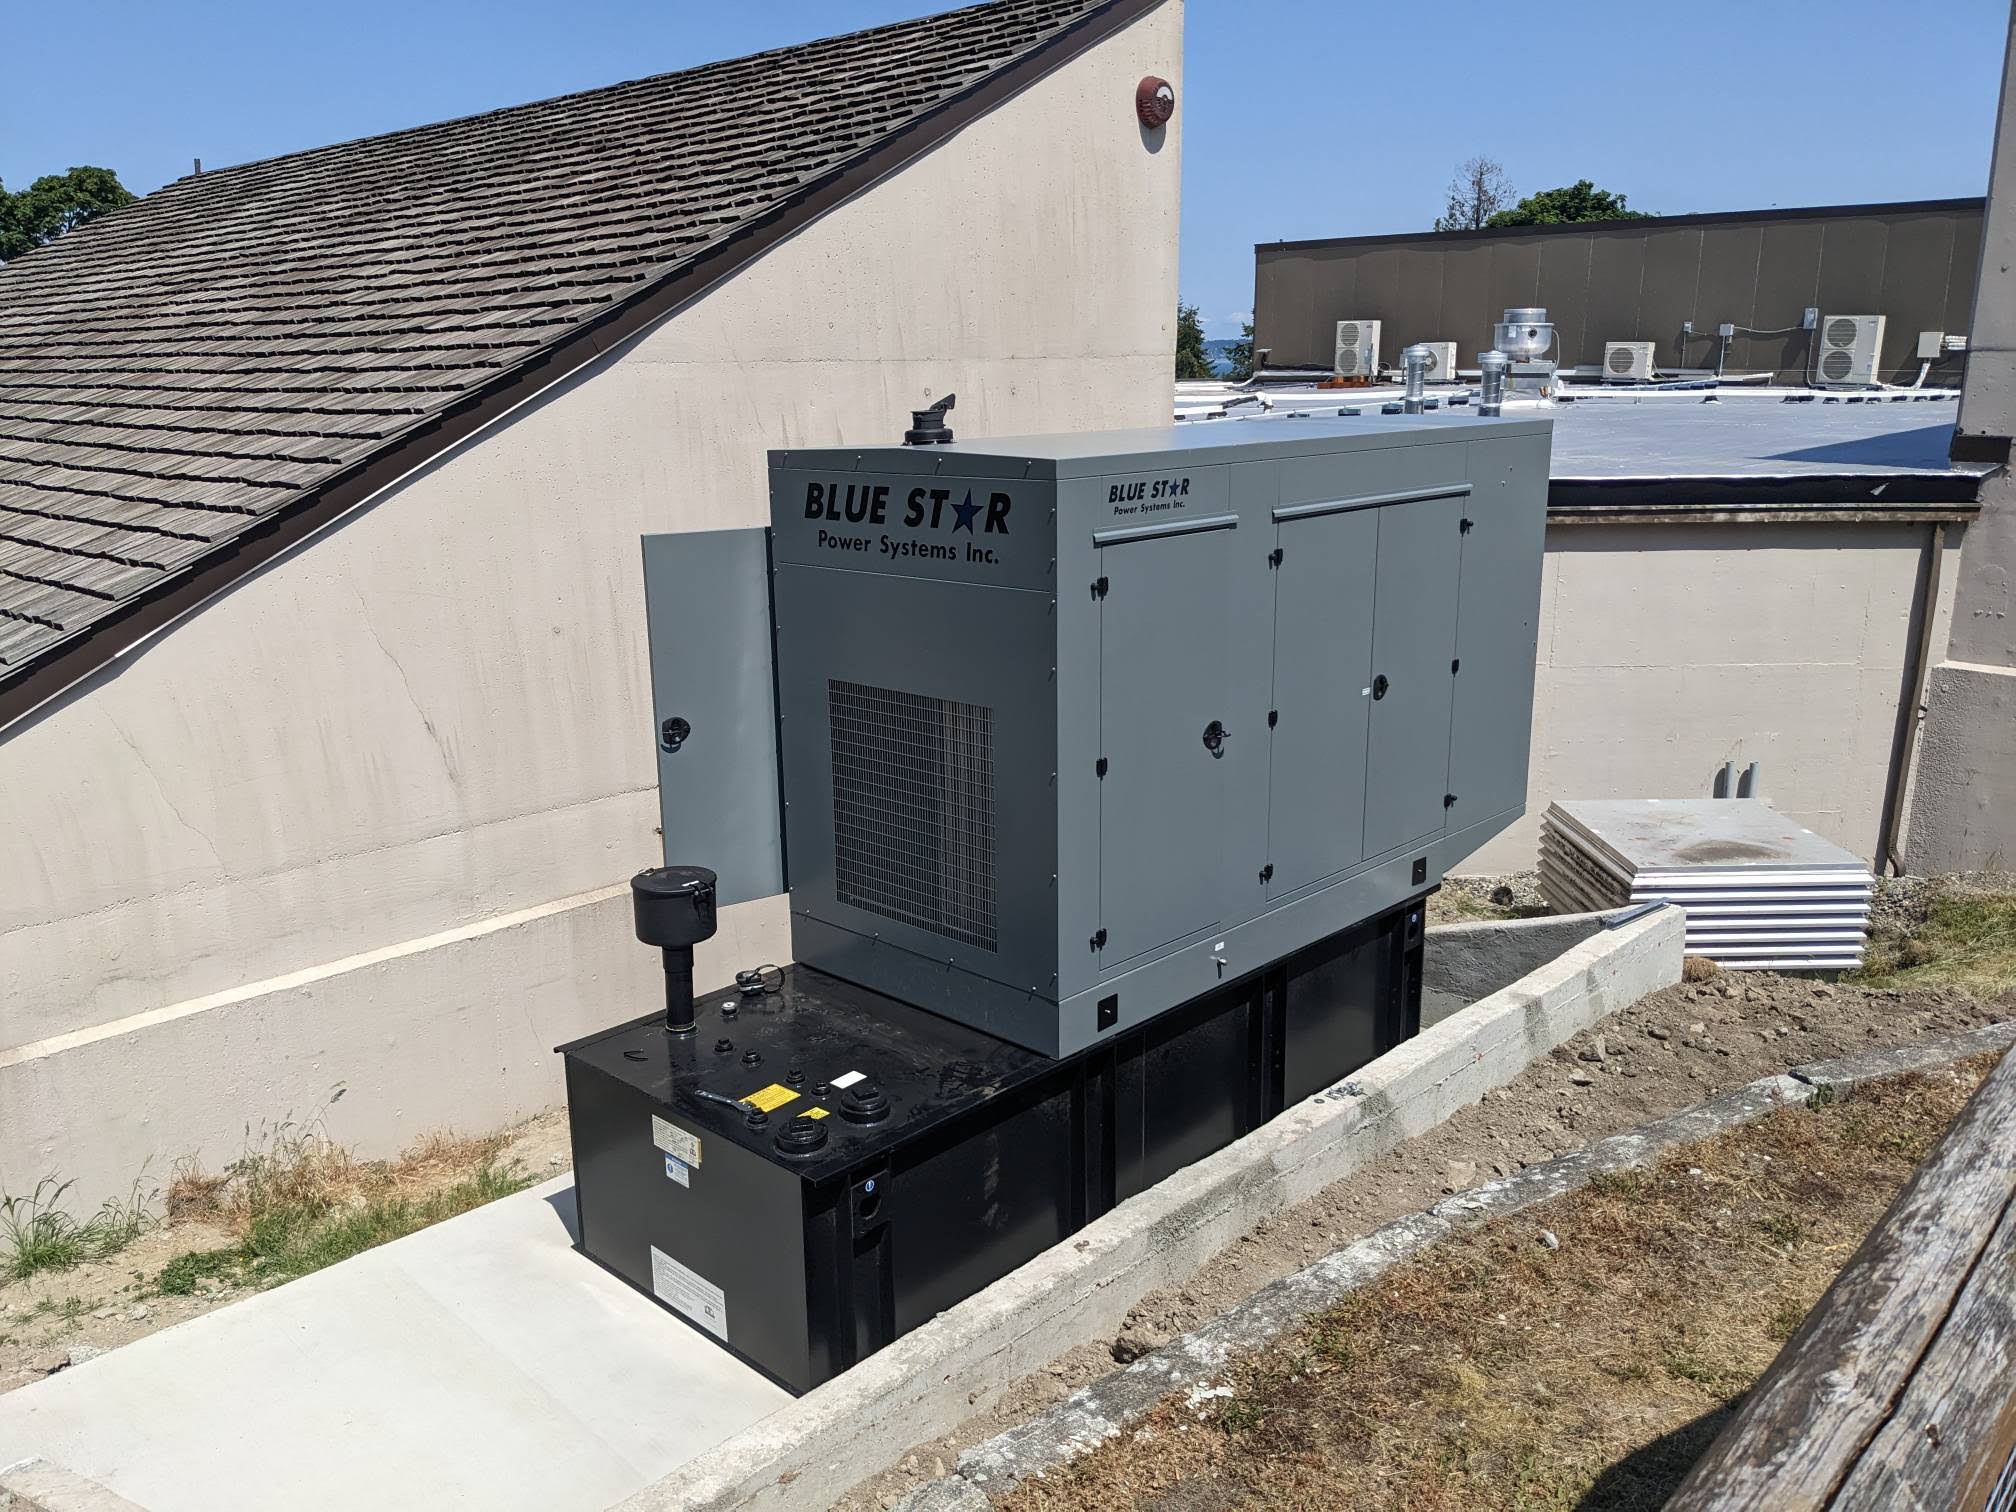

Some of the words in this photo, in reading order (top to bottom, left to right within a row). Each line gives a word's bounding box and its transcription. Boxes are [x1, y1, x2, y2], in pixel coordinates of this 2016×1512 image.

[804, 482, 890, 525] BLUE
[1108, 482, 1147, 503] BLUE
[1113, 505, 1138, 516] Power
[1140, 502, 1171, 515] Systems
[1173, 499, 1186, 509] Inc.
[818, 529, 872, 553] Power
[880, 534, 957, 560] Systems
[966, 541, 1000, 565] Inc.
